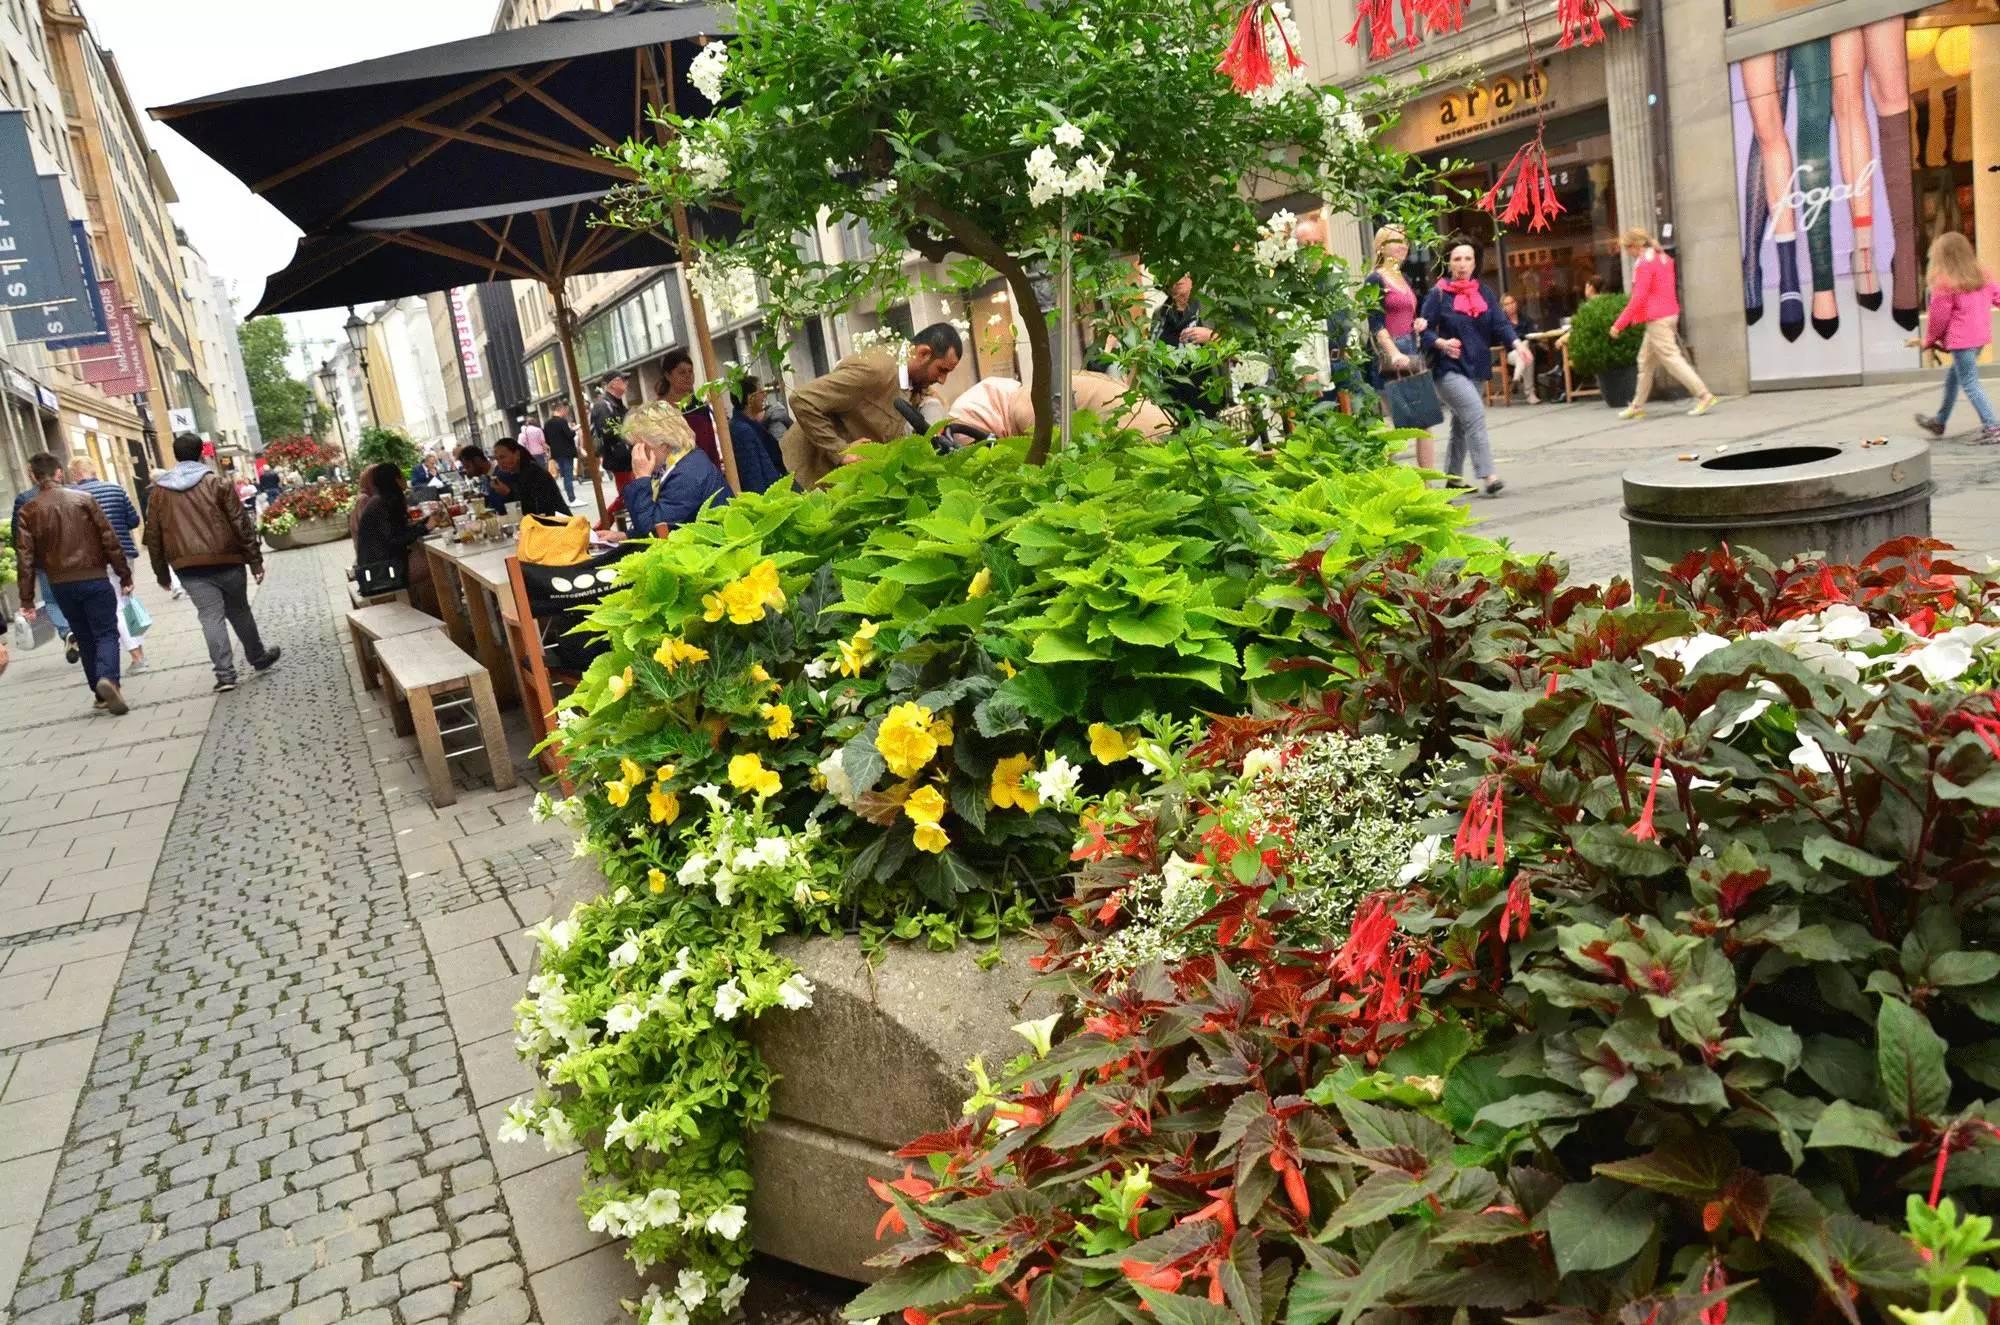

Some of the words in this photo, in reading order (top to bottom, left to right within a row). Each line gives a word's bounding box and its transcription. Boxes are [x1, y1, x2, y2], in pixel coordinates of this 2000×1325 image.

[1440, 70, 1542, 125] aran
[1764, 159, 1877, 241] fogal
[99, 287, 117, 320] KORS
